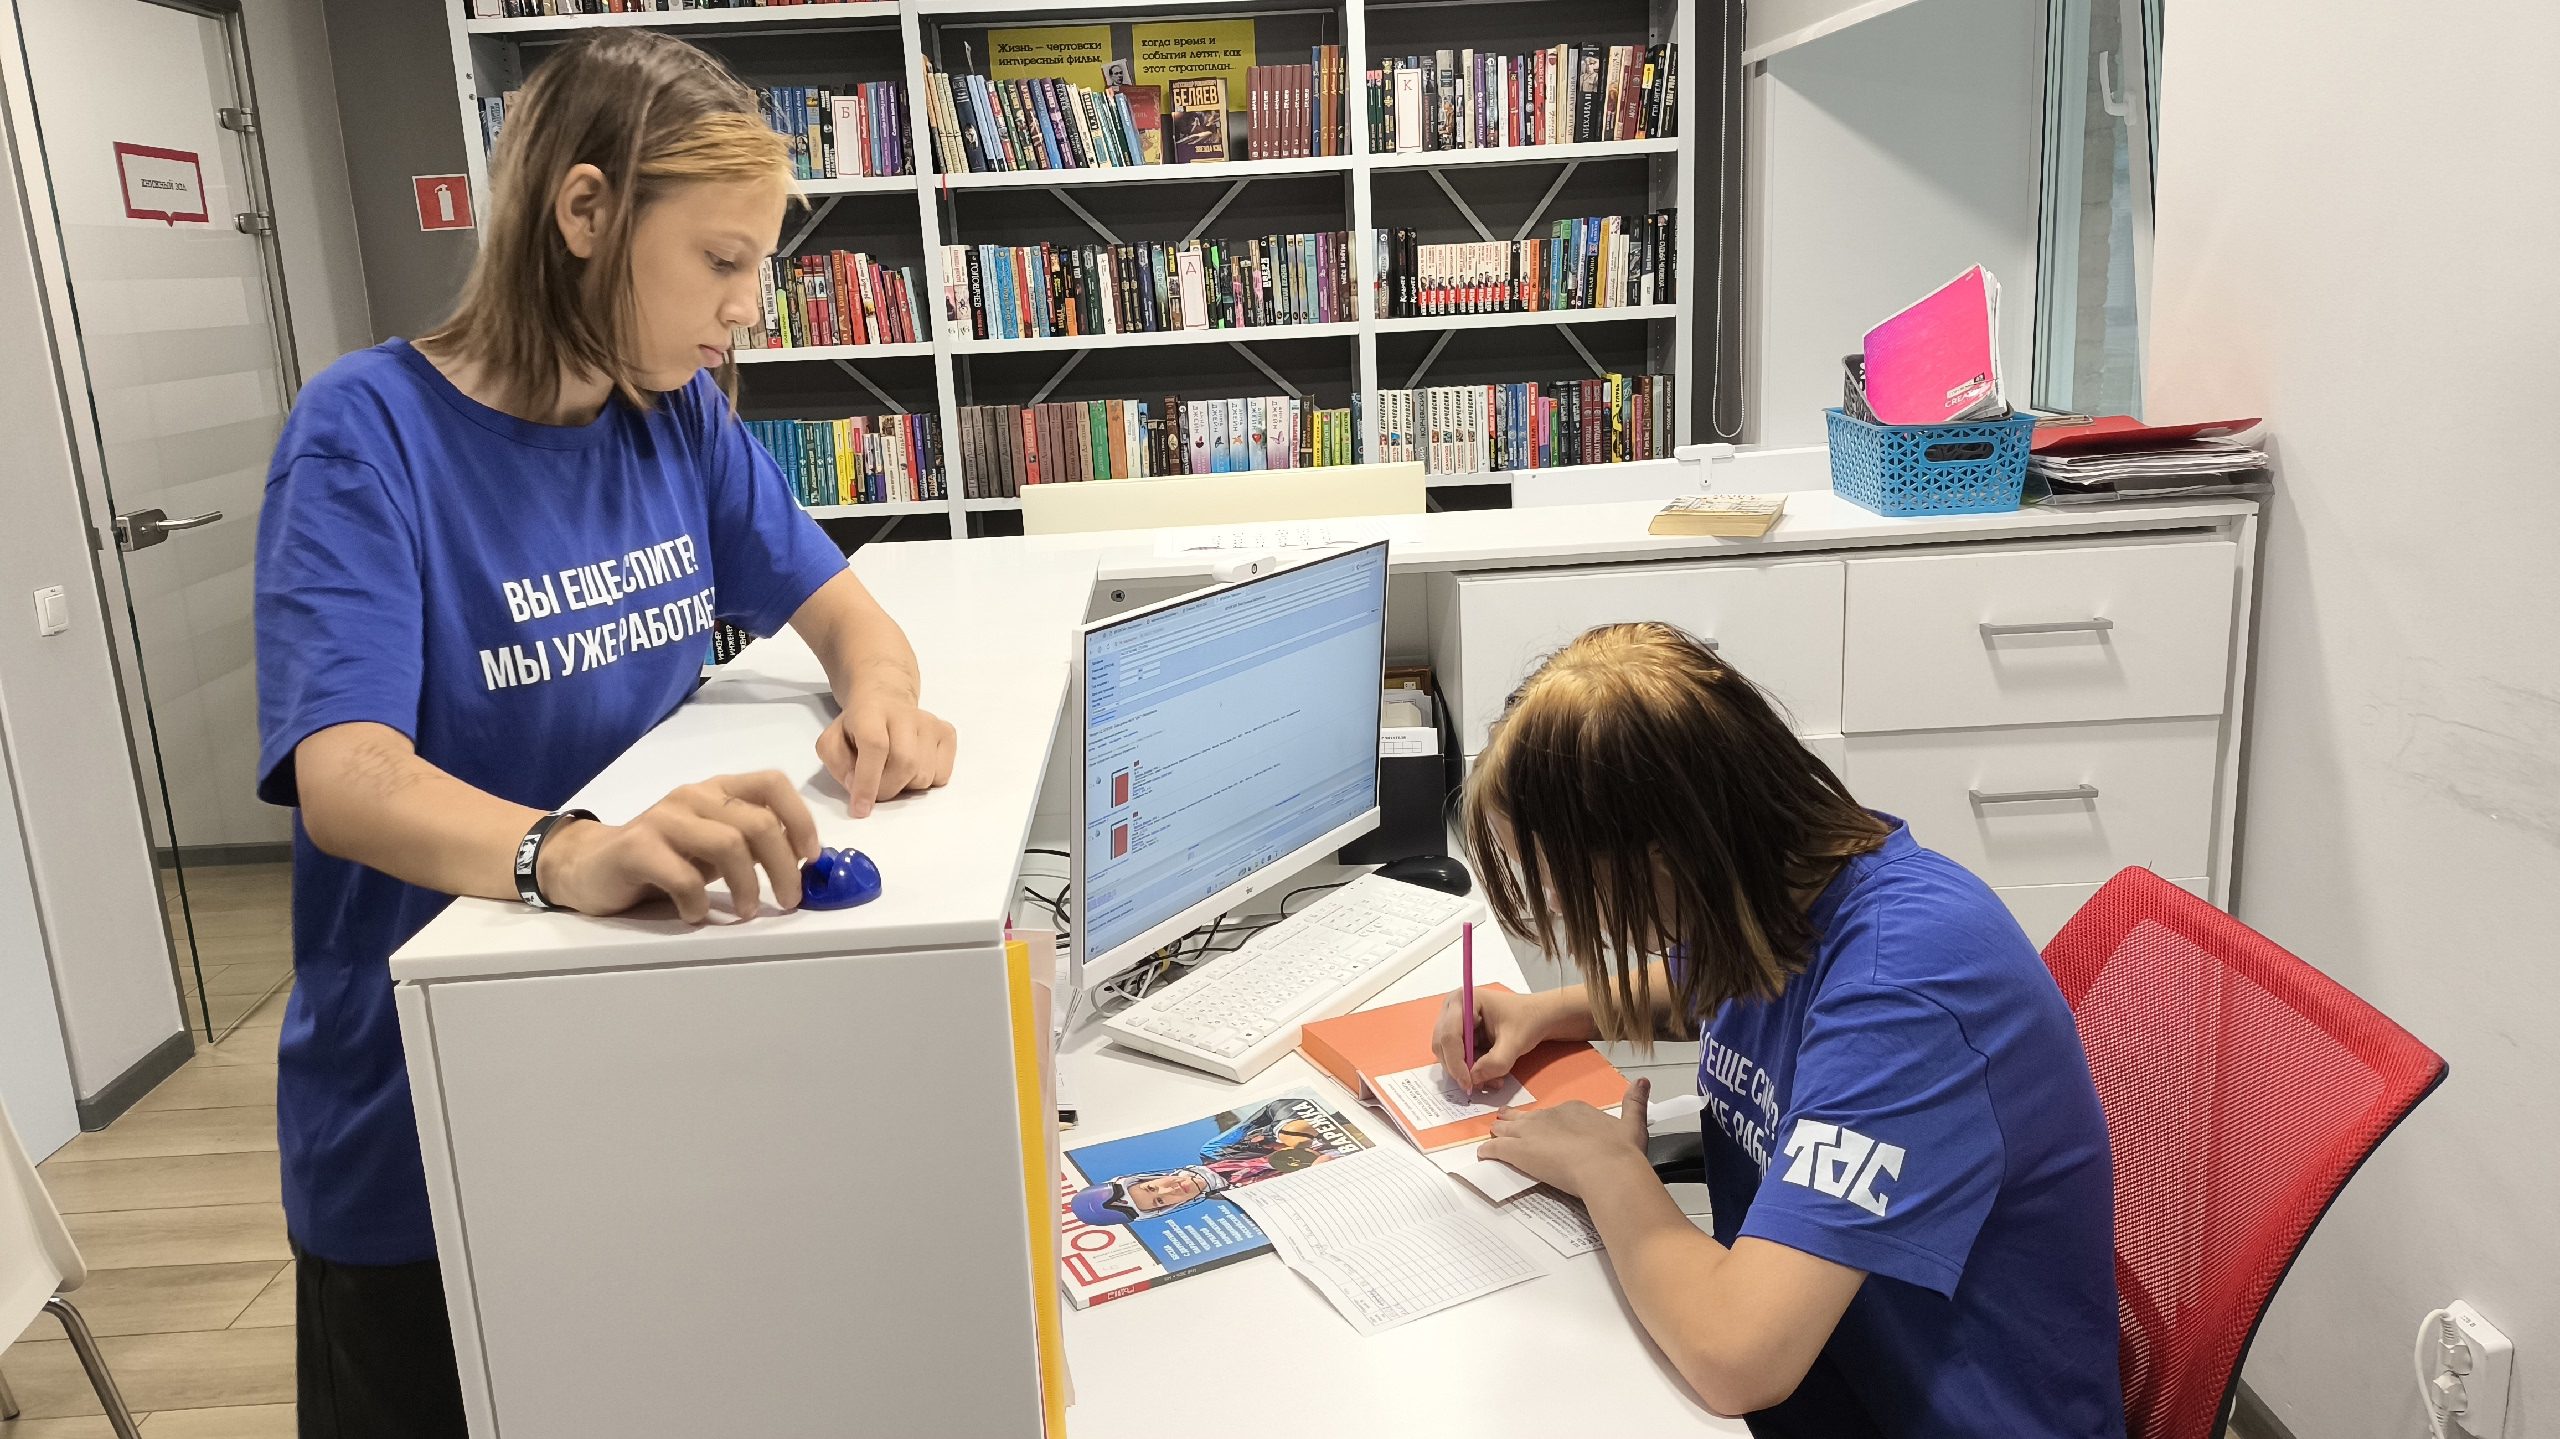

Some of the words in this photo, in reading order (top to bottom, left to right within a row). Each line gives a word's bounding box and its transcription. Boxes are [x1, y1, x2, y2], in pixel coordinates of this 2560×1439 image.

[998, 42, 1034, 52] Жизнь
[1046, 41, 1102, 51] чертовски
[1141, 38, 1171, 48] когда
[1174, 37, 1206, 48] время
[1208, 36, 1216, 45] и
[1142, 50, 1187, 61] события
[1189, 49, 1221, 60] летят,
[1223, 48, 1242, 58] как
[1143, 63, 1166, 74] этот
[1173, 86, 1219, 106] БЕЛЯЕВ
[842, 106, 850, 119] Б
[1582, 100, 1592, 139] МИХАИЛ
[1185, 261, 1197, 275] А
[970, 262, 982, 307] ГОЛОВАЧЕВ
[502, 574, 561, 623] ВЫ
[559, 559, 624, 611] ЕЩЕ
[479, 640, 551, 691] МЫ
[552, 622, 618, 676] УЖЕ
[618, 586, 716, 656] РАБОТАЕ
[715, 630, 723, 661] ИНЖЕНЕР
[726, 624, 736, 656] ИНЖЕНЕР
[1706, 1038, 1753, 1096] ЕЩЕ
